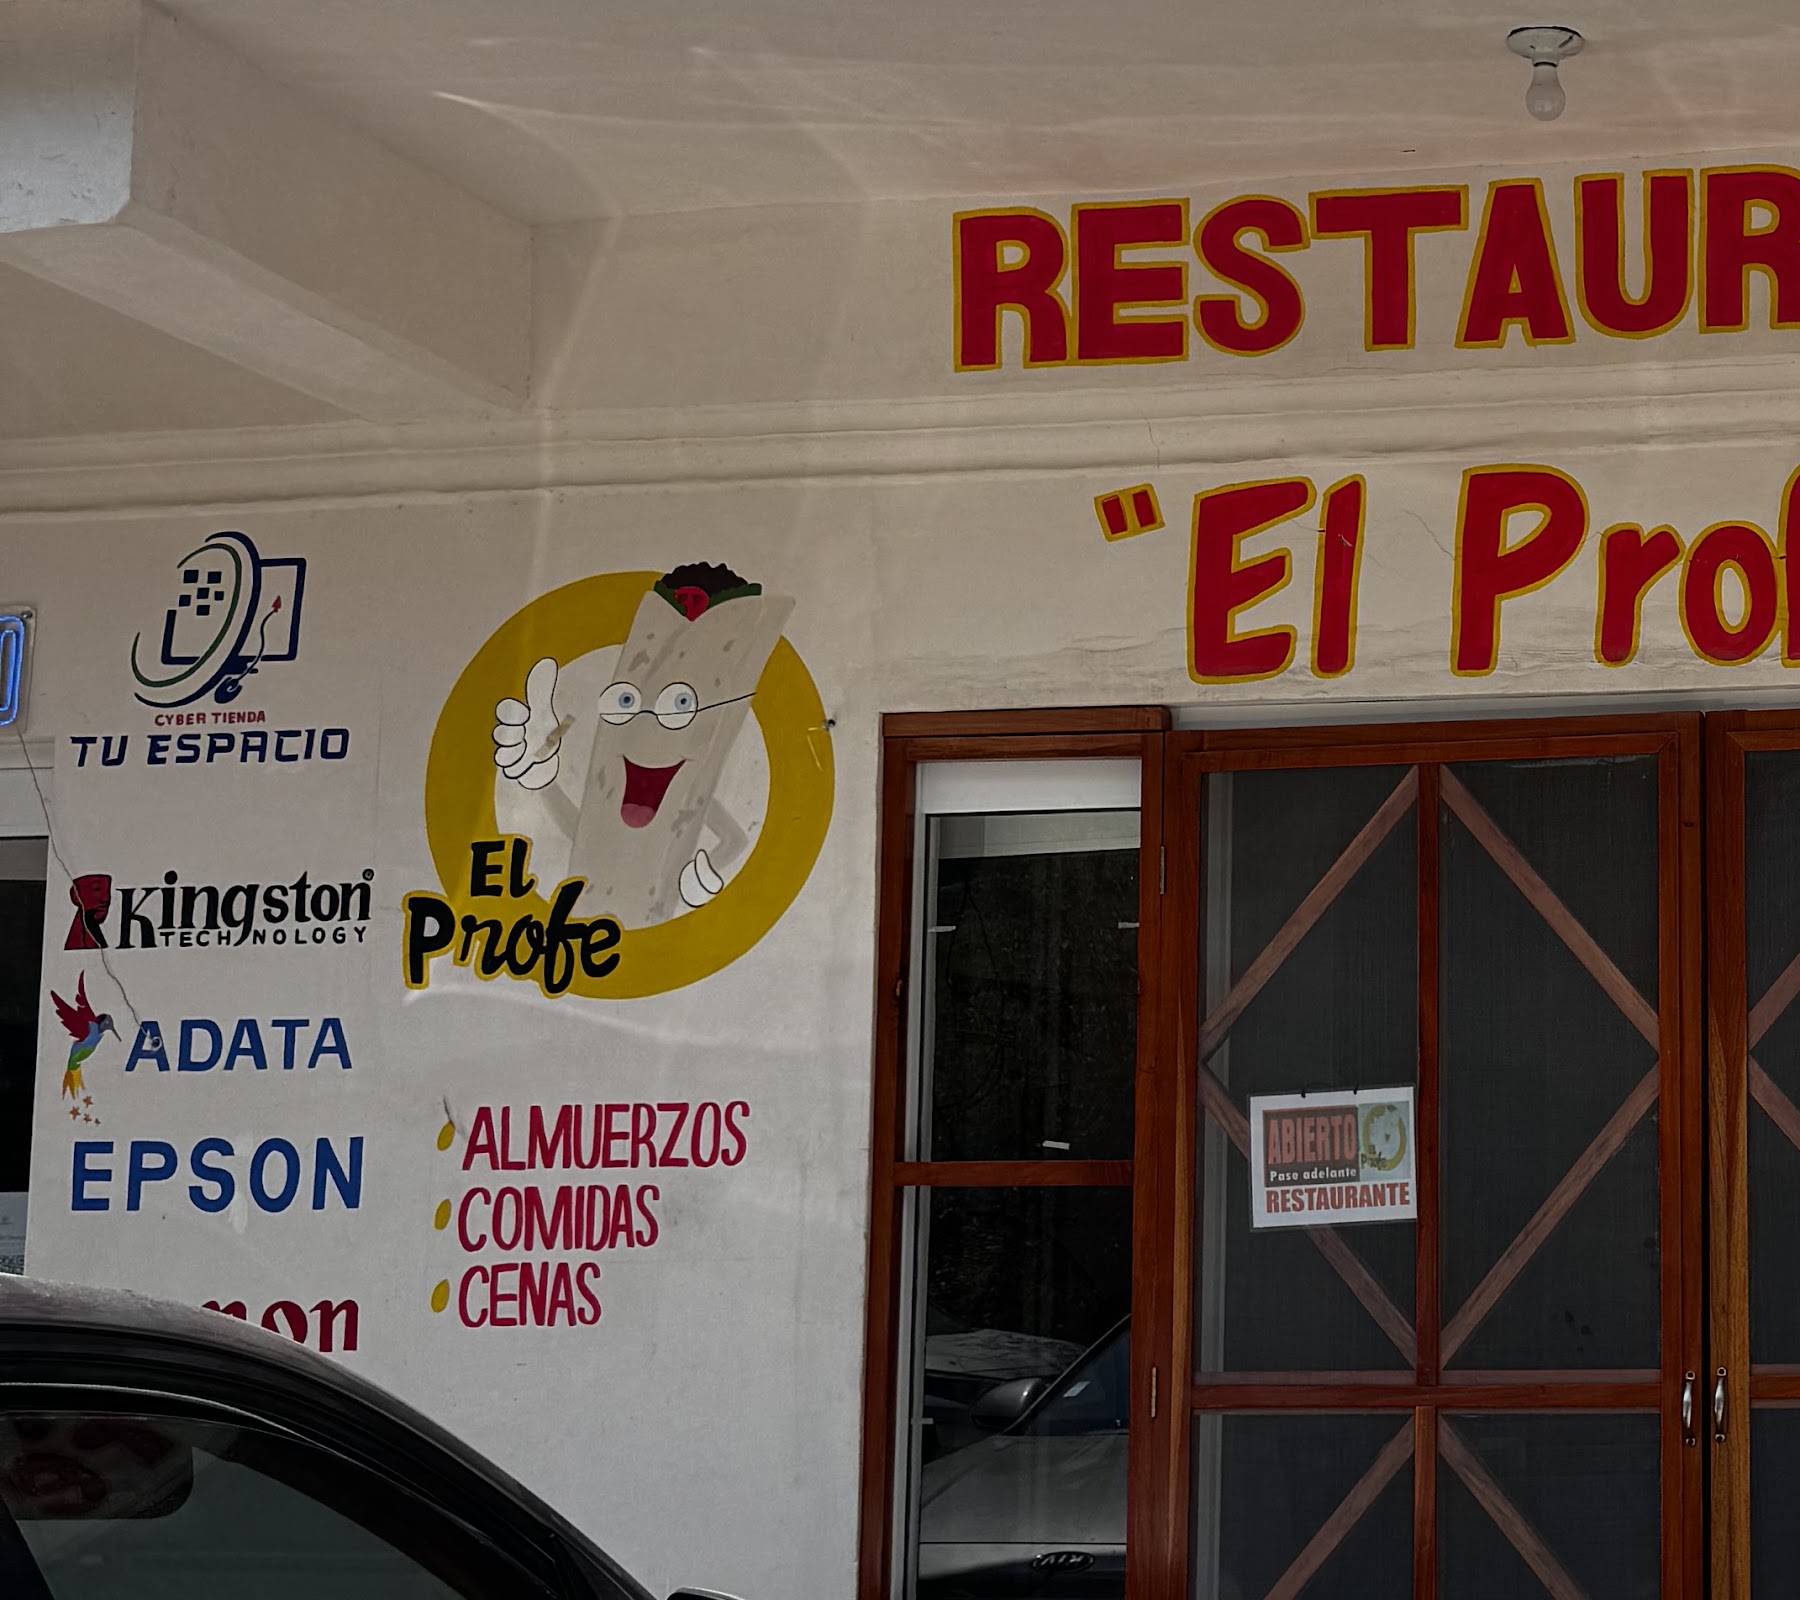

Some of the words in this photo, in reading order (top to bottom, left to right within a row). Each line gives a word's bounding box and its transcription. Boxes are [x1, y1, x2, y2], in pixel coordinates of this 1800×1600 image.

[154, 712, 206, 726] CYBER
[211, 710, 266, 724] TIENDA
[70, 735, 128, 767] TU
[147, 728, 350, 765] ESPACIO
[470, 838, 535, 898] El
[115, 870, 372, 949] Kingston
[159, 926, 367, 947] TECHNOLOGY
[408, 880, 621, 994] Profe
[125, 1018, 352, 1073] ADATA
[462, 1101, 750, 1171] ALMUERZOS
[1268, 1114, 1357, 1165] ABIERTO
[71, 1136, 364, 1213] EPSON
[1266, 1182, 1410, 1214] RESTAURANTE
[1269, 1170, 1299, 1182] Pase
[1303, 1167, 1357, 1180] adelante
[457, 1184, 660, 1252] COMIDAS
[457, 1261, 602, 1328] CENAS
